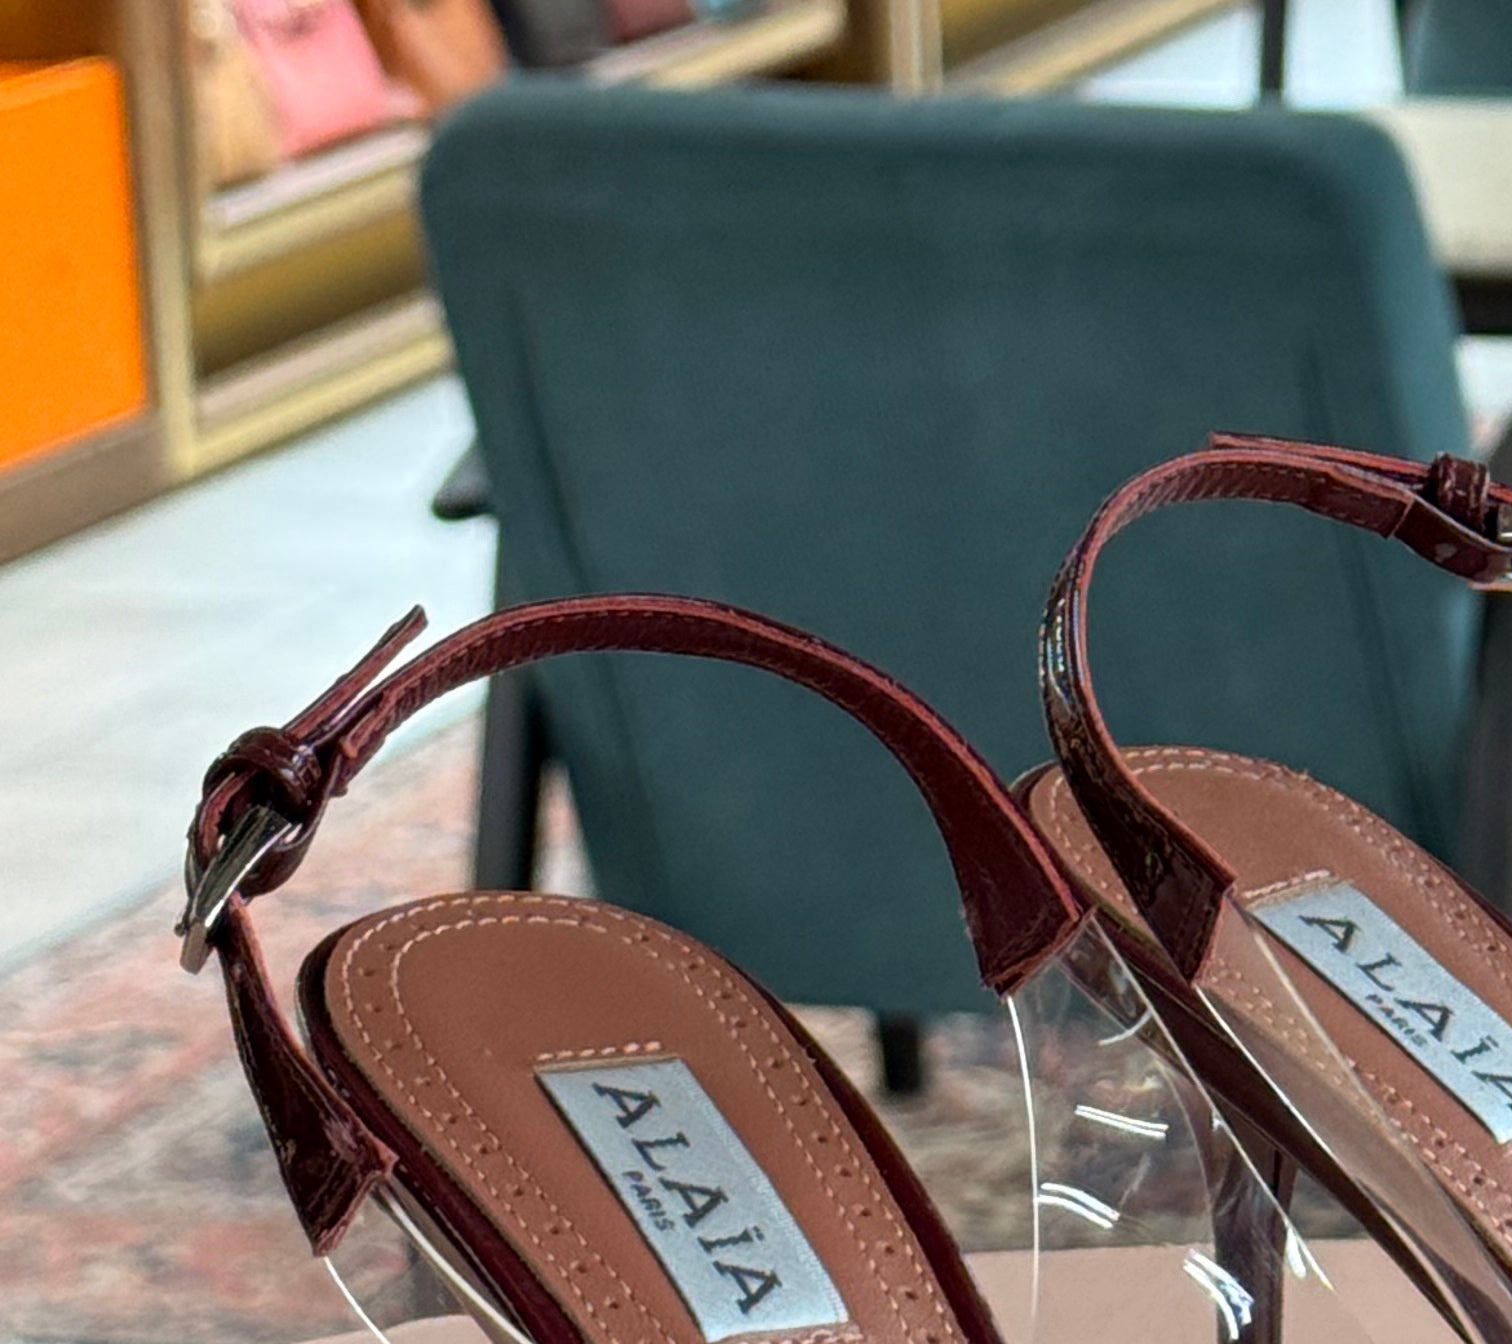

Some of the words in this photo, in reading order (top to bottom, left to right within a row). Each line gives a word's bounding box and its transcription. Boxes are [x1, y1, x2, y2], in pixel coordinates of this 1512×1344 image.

[1365, 994, 1429, 1048] PARIS
[592, 1082, 782, 1315] ALAÏA
[622, 1170, 676, 1232] PARIS
